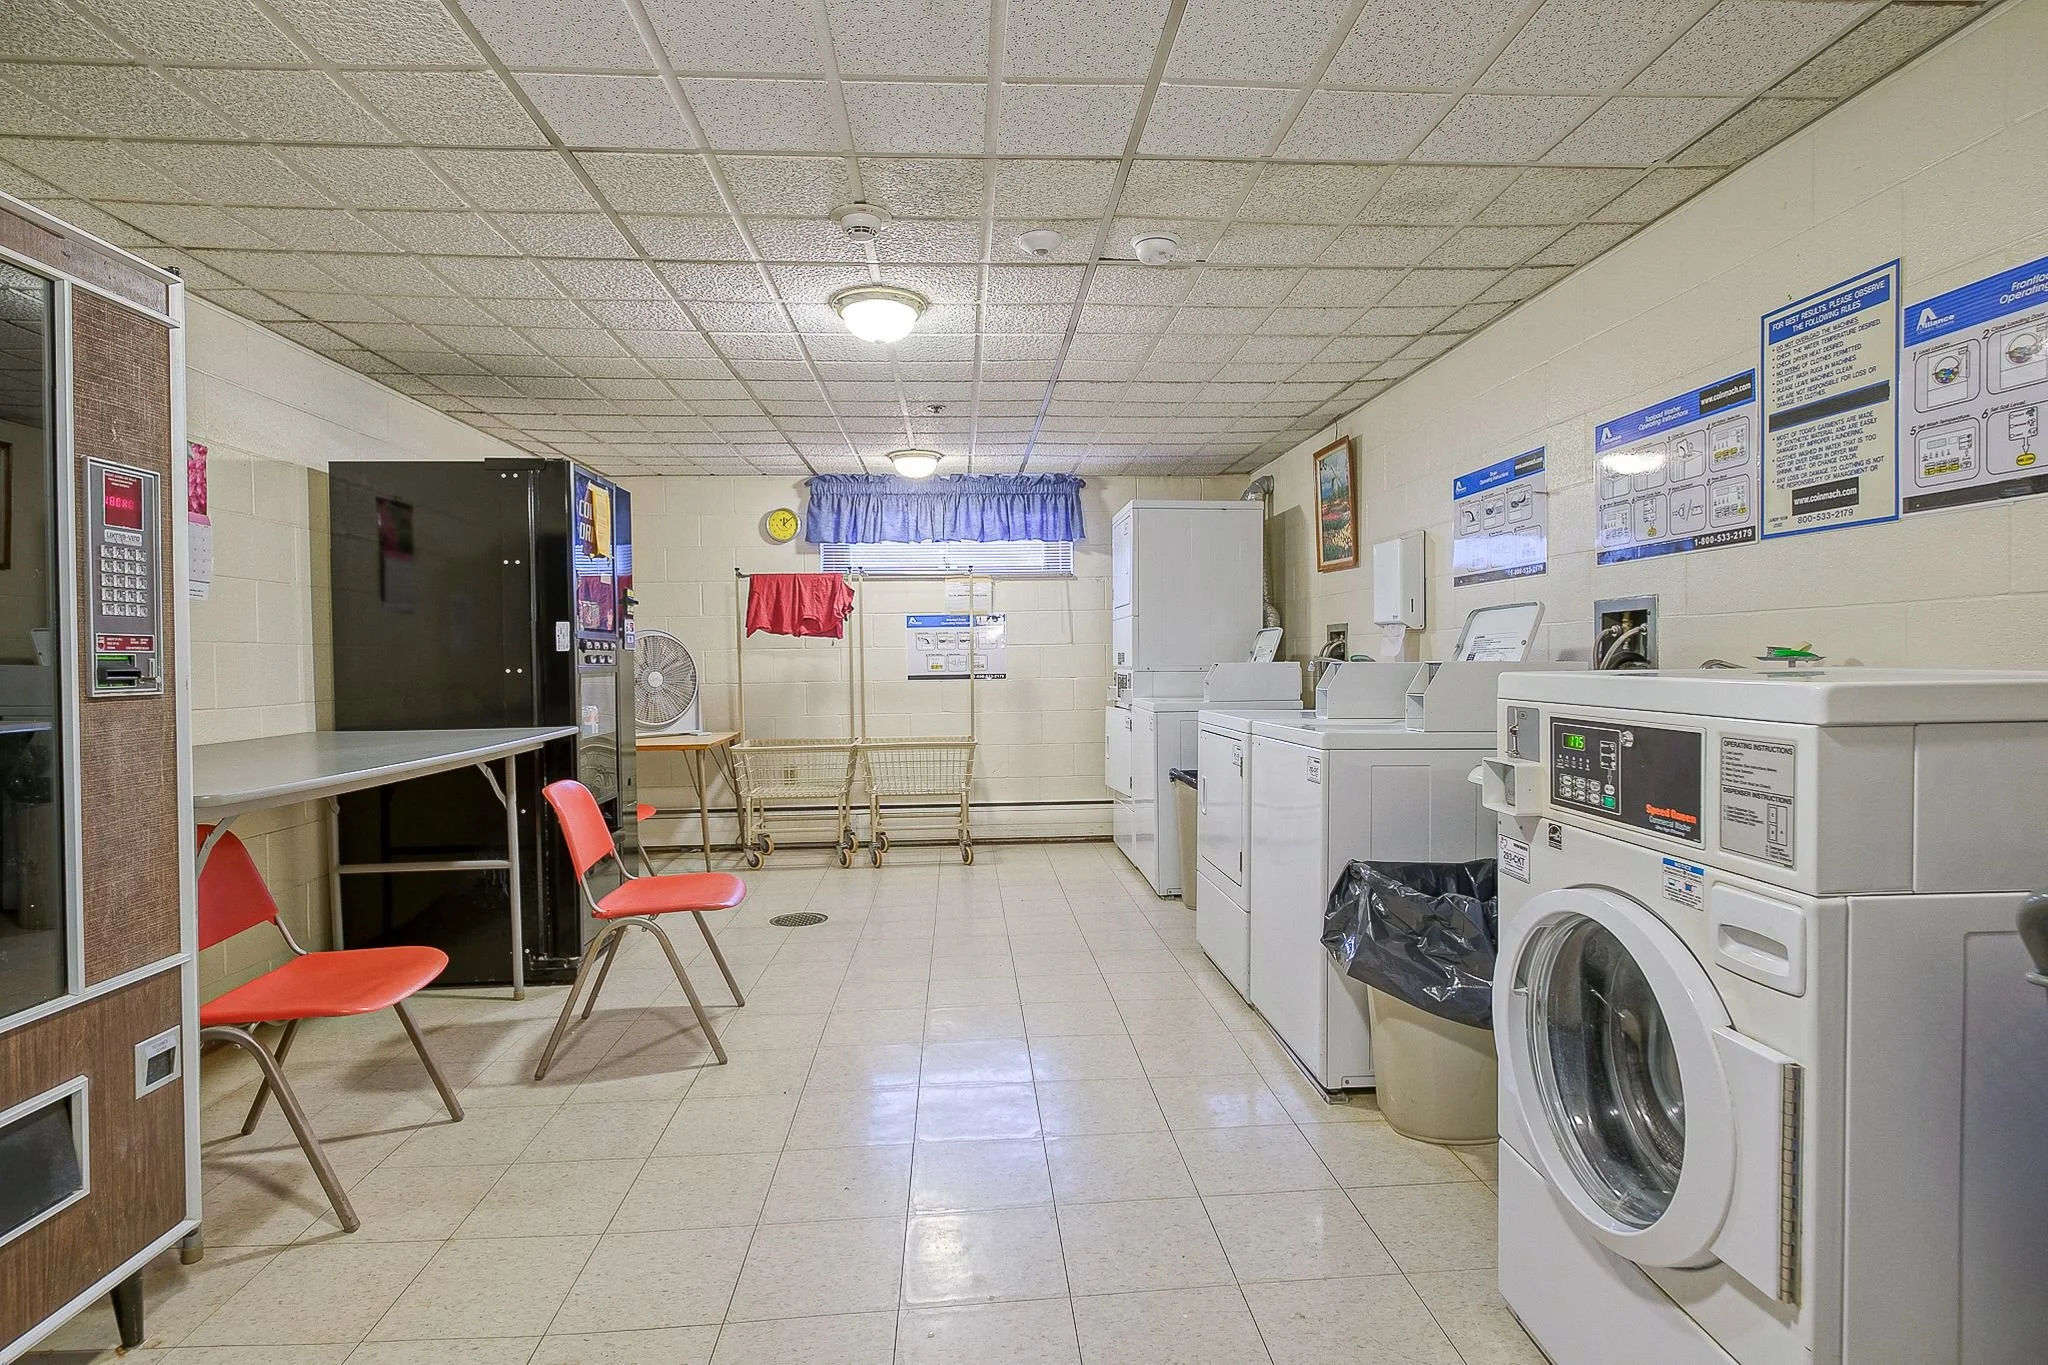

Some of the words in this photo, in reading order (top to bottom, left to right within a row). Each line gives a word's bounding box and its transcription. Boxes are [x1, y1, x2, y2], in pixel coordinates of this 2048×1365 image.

[1773, 322, 1784, 331] FOR
[1785, 316, 1799, 326] BEST
[1829, 295, 1852, 309] PLEASE
[1855, 282, 1885, 299] OBSERVE
[1793, 323, 1804, 332] THE
[1805, 310, 1839, 328] FOLLOWING
[1982, 329, 1990, 340] 2
[1701, 382, 1751, 406] www.coinmach.com
[1982, 409, 1988, 419] 6
[1910, 426, 1916, 436] 5
[1794, 487, 1857, 505] www.coinmach.com
[1798, 509, 1854, 523] 800-533-2179
[1694, 528, 1752, 546] 1-800-533-2179
[1724, 740, 1752, 749] OPERATING
[1753, 744, 1793, 755] INSTRUCTIONS
[1752, 792, 1792, 805] INSTRUCTIONS
[1646, 803, 1670, 818] Speed
[1671, 808, 1697, 824] Queen
